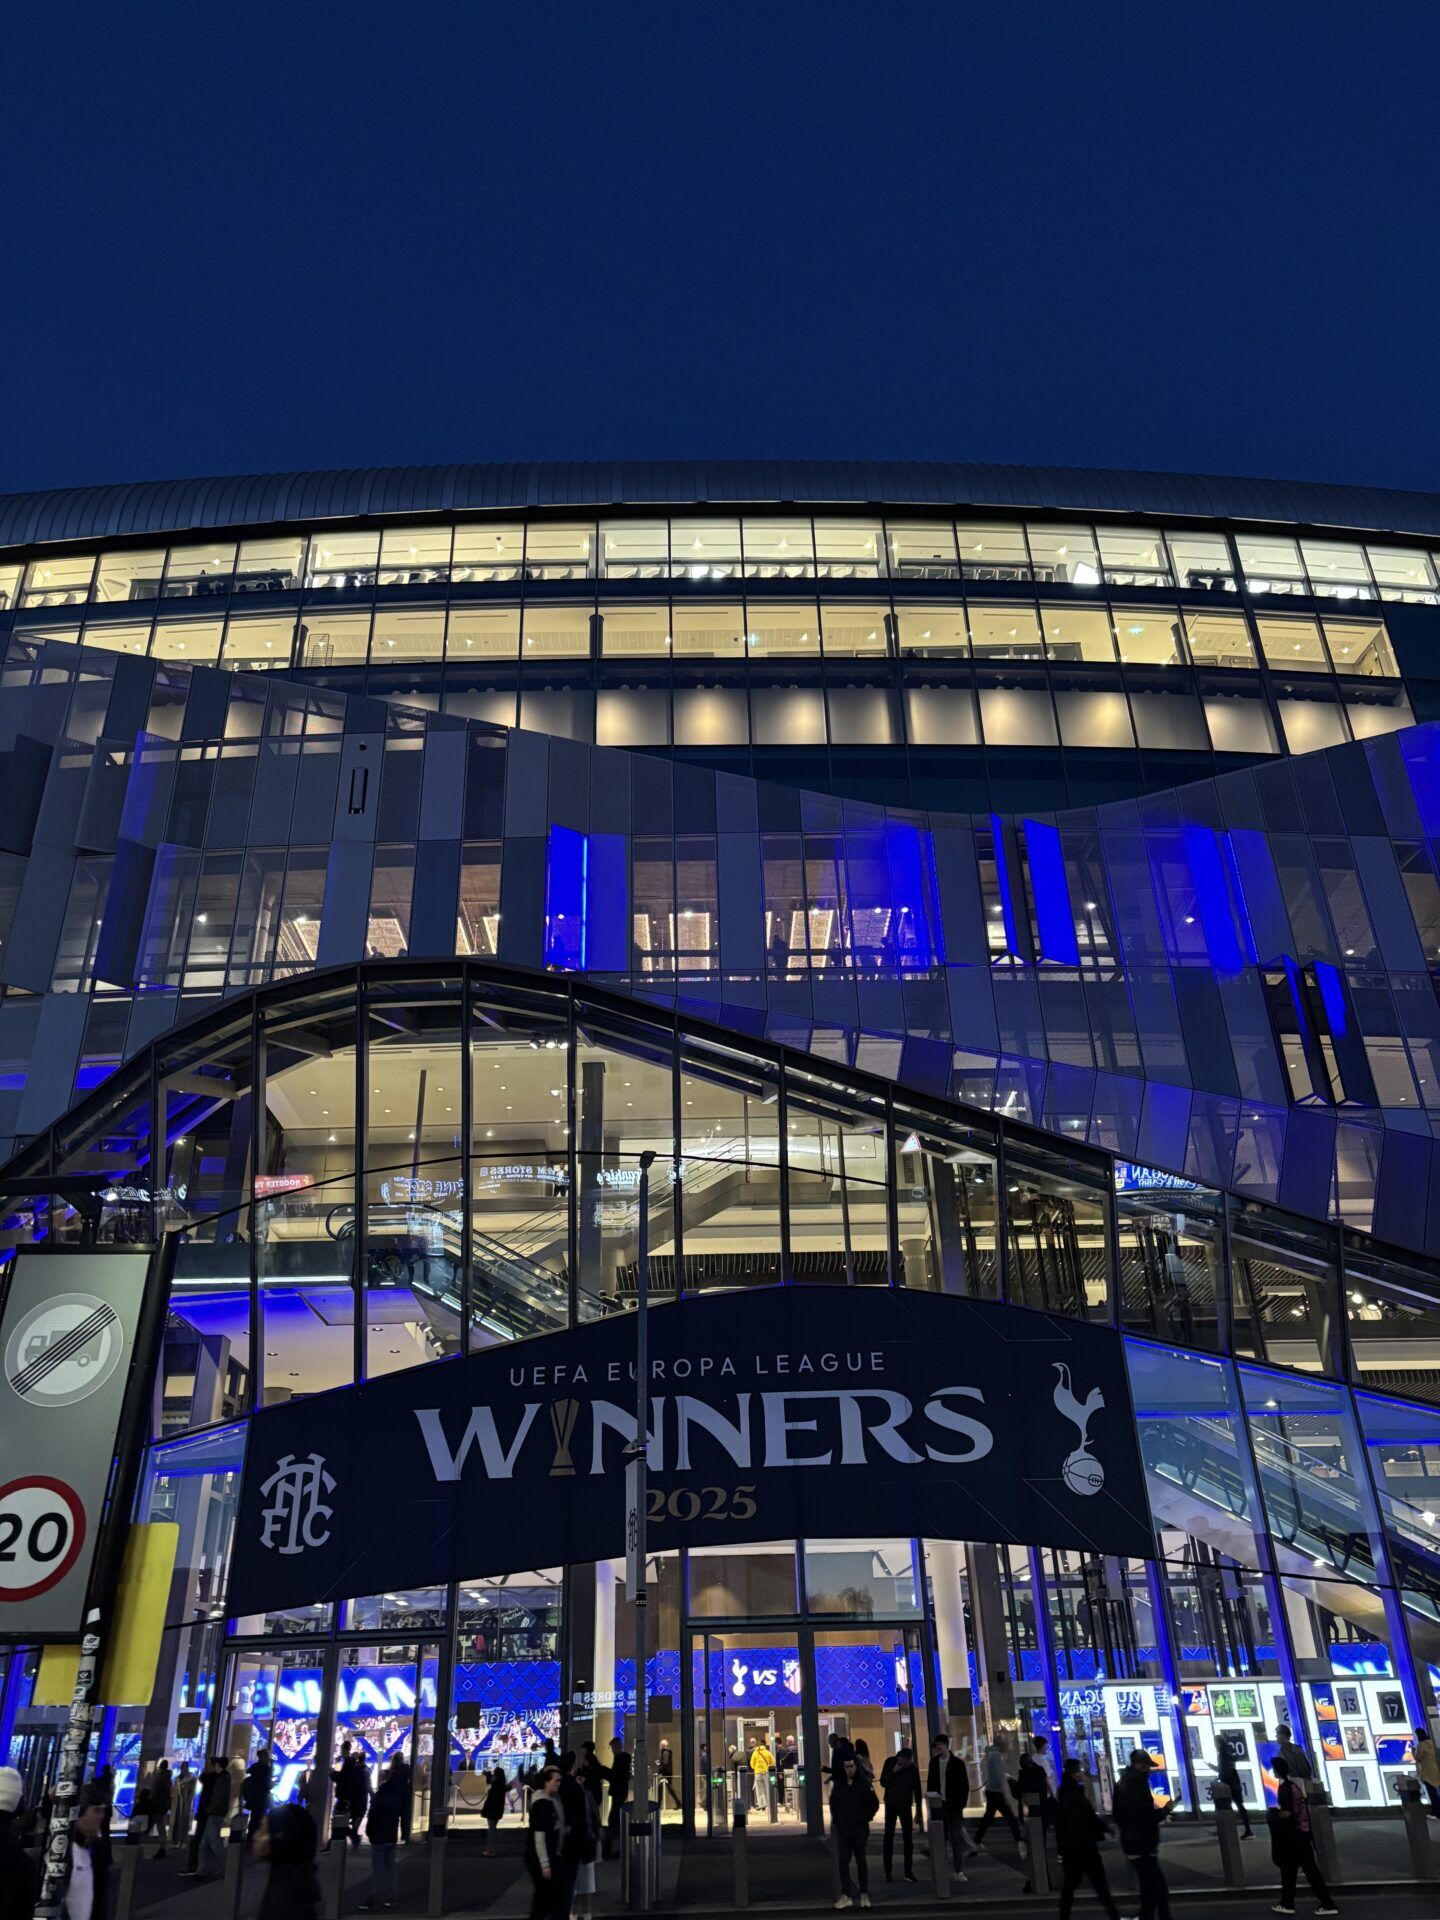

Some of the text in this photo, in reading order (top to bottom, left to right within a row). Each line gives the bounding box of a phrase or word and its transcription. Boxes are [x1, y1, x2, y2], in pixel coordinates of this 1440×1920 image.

[510, 1364, 588, 1387] UEFA
[756, 1352, 885, 1375] LEAGUE
[646, 1484, 757, 1523] 2025
[0, 1511, 68, 1563] 20
[1343, 1698, 1357, 1712] 13
[1385, 1703, 1399, 1719] 17
[1350, 1779, 1360, 1793] 7
